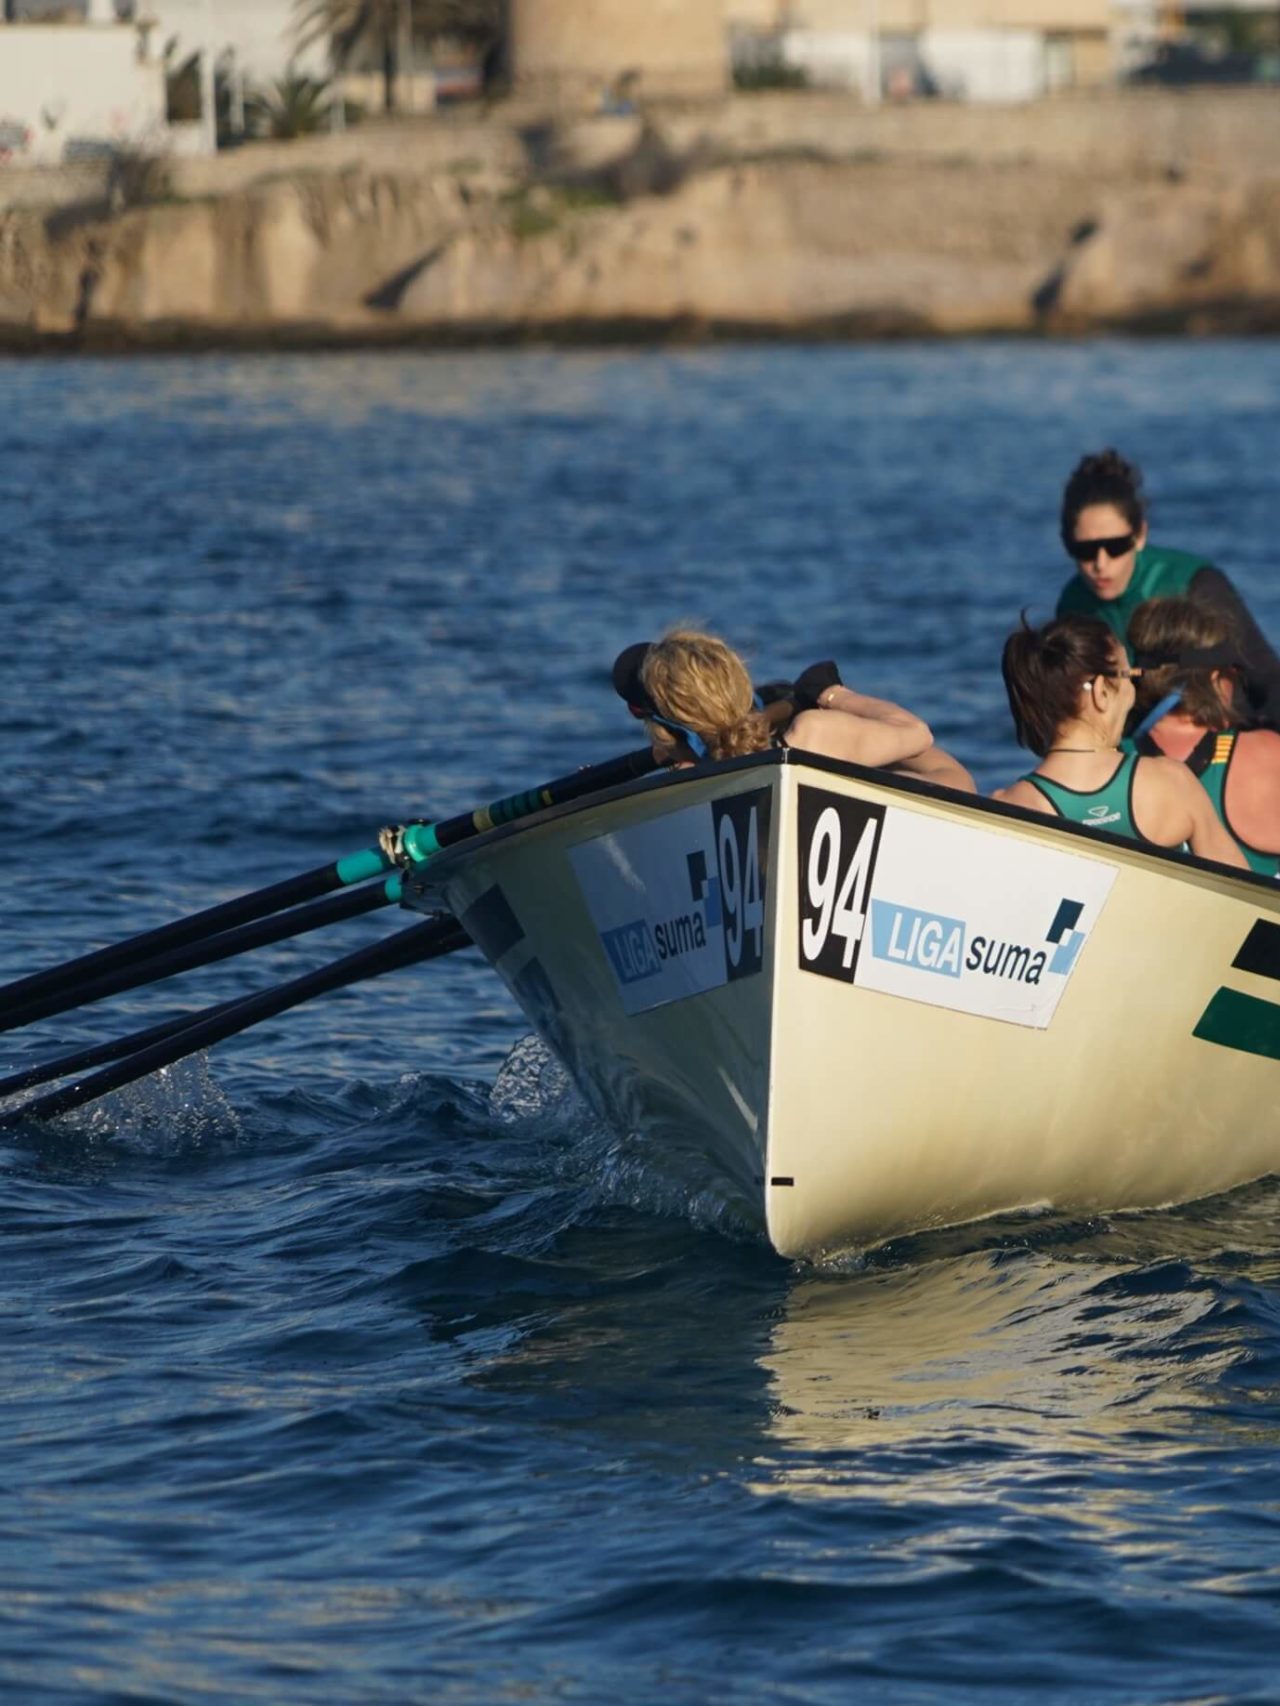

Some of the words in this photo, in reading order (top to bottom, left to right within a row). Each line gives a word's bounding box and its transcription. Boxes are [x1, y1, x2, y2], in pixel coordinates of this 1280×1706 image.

[614, 926, 660, 976] LIGA
[655, 912, 706, 960] suma
[719, 806, 764, 968] 94
[803, 807, 878, 969] 94
[887, 912, 961, 973] LIGA
[965, 936, 1047, 985] suma
